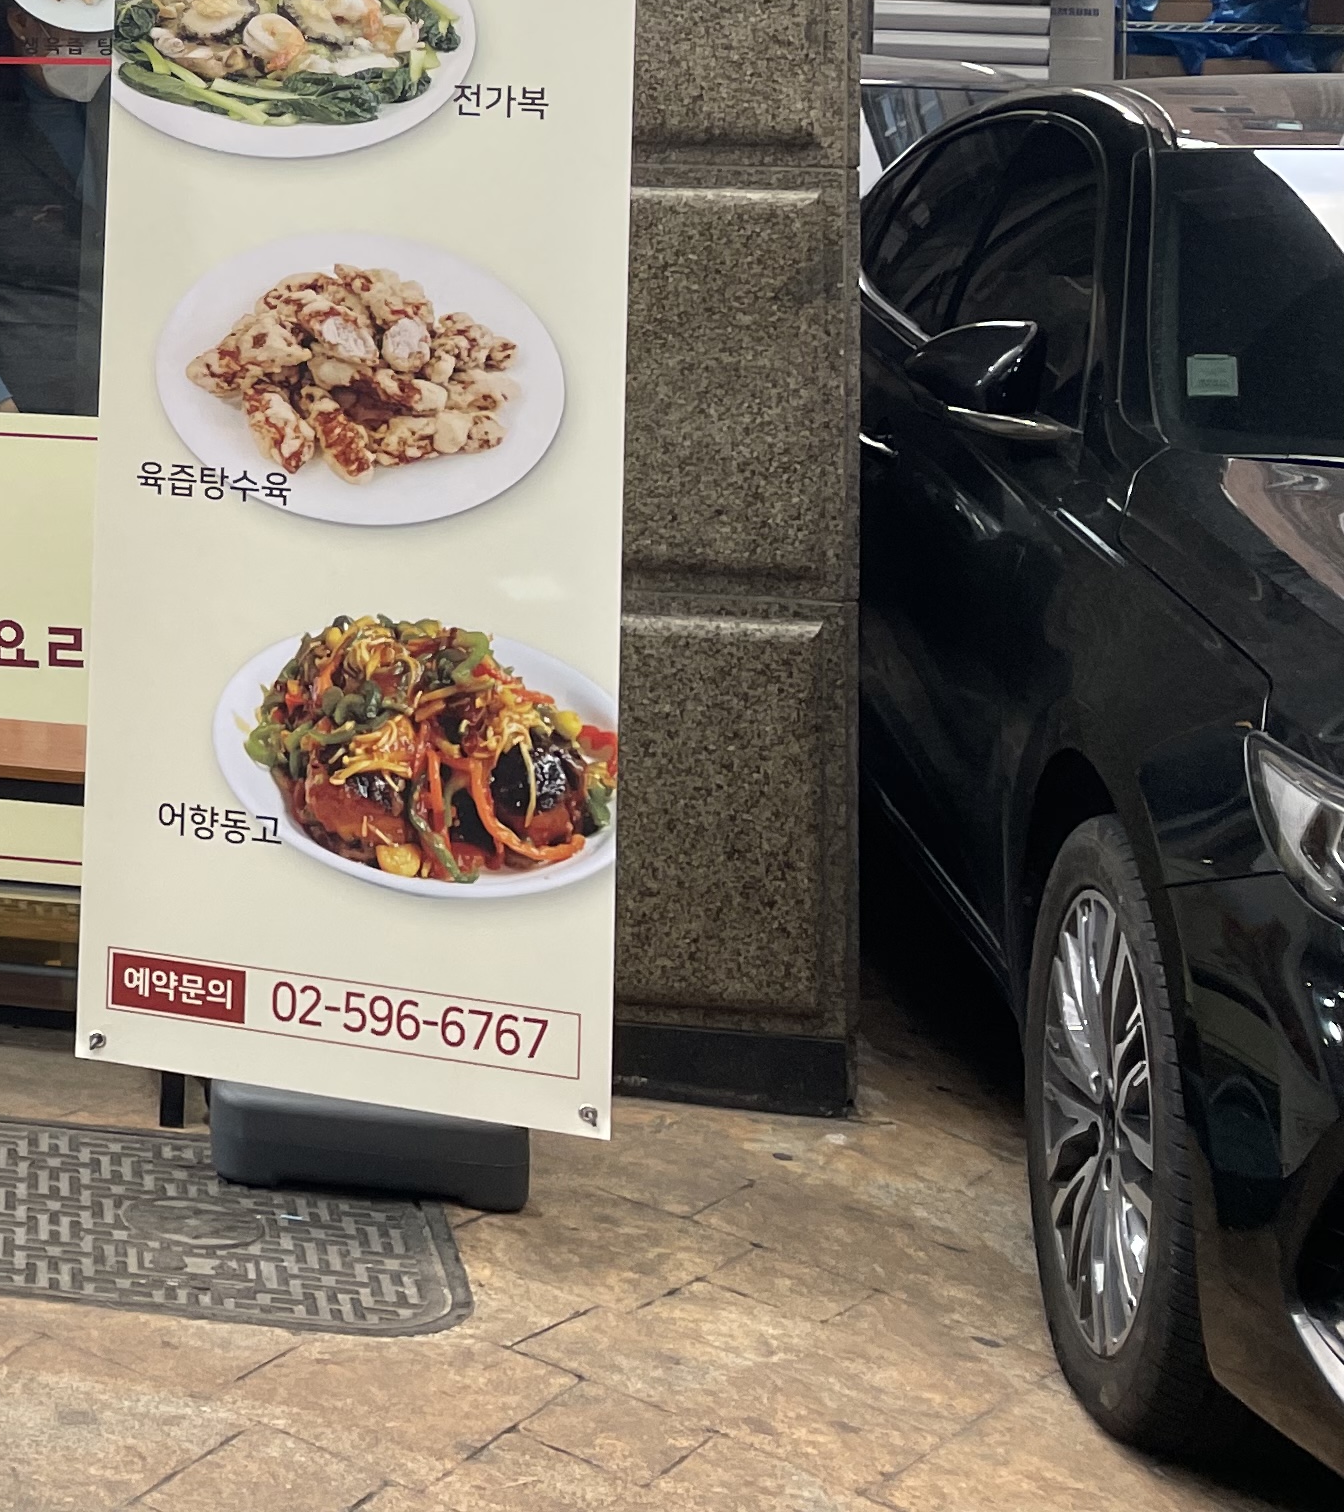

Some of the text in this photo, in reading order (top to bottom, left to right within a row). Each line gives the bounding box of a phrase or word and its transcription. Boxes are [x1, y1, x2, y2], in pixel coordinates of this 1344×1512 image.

[452, 82, 550, 119] 전가복
[136, 461, 292, 505] 육즙탕수육
[158, 802, 283, 846] 어향동고
[123, 966, 549, 1060] 예약문의 02-596-6767
